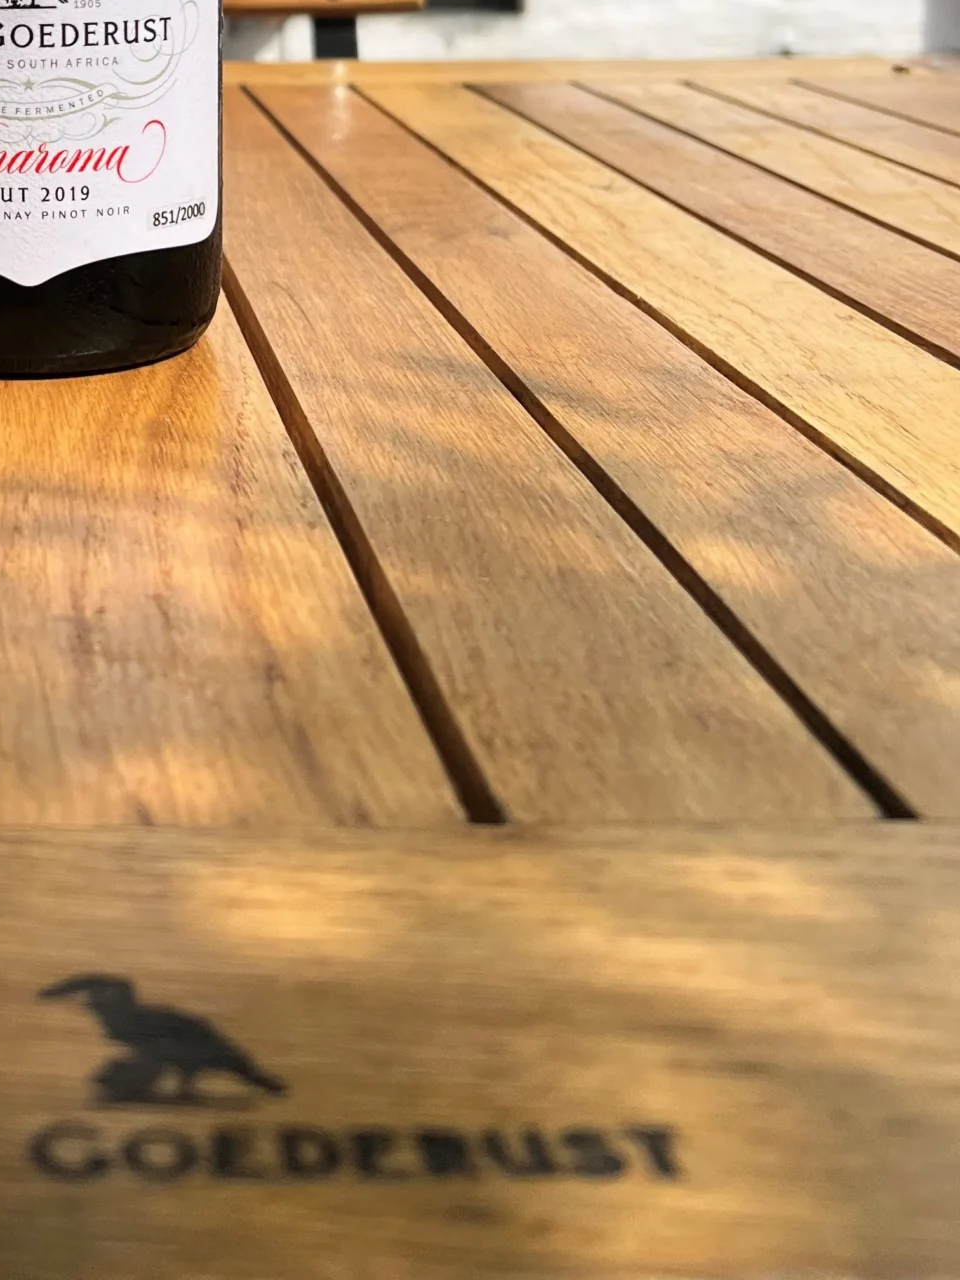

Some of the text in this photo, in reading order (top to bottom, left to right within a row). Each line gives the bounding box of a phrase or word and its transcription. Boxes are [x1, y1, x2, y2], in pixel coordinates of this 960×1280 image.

[73, 0, 101, 10] 1905
[7, 59, 58, 70] SOUTH
[65, 56, 119, 69] AFRICA
[15, 88, 105, 115] FERMENTED
[41, 185, 90, 202] 2019
[41, 209, 87, 220] PINOT
[96, 205, 131, 218] NOIR
[152, 201, 206, 227] 851/2000
[25, 1122, 683, 1183] GOEDERUST
